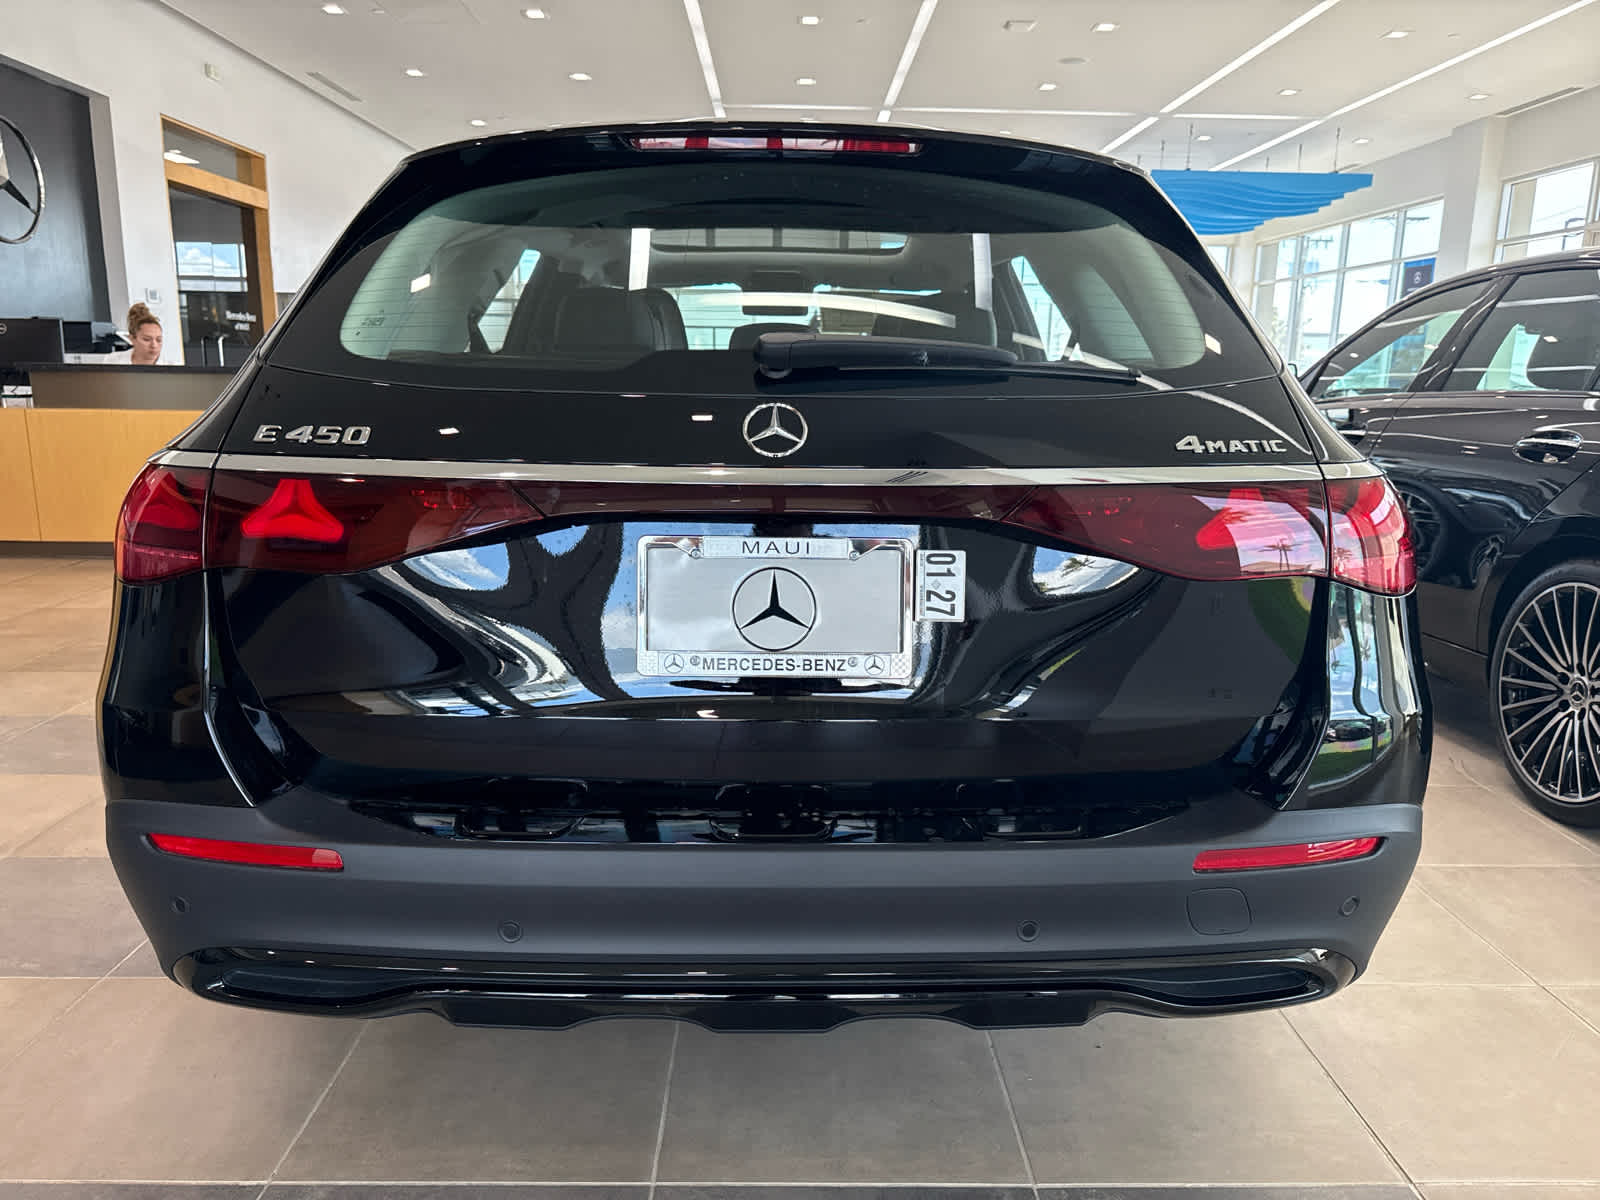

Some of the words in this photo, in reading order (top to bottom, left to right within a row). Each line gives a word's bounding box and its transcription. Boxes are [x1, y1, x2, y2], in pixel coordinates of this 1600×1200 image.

[253, 424, 282, 442] E
[285, 425, 371, 445] 450
[1175, 435, 1287, 453] 4MATIC
[742, 541, 810, 555] MAUI
[926, 553, 957, 576] 01
[926, 590, 956, 616] 27
